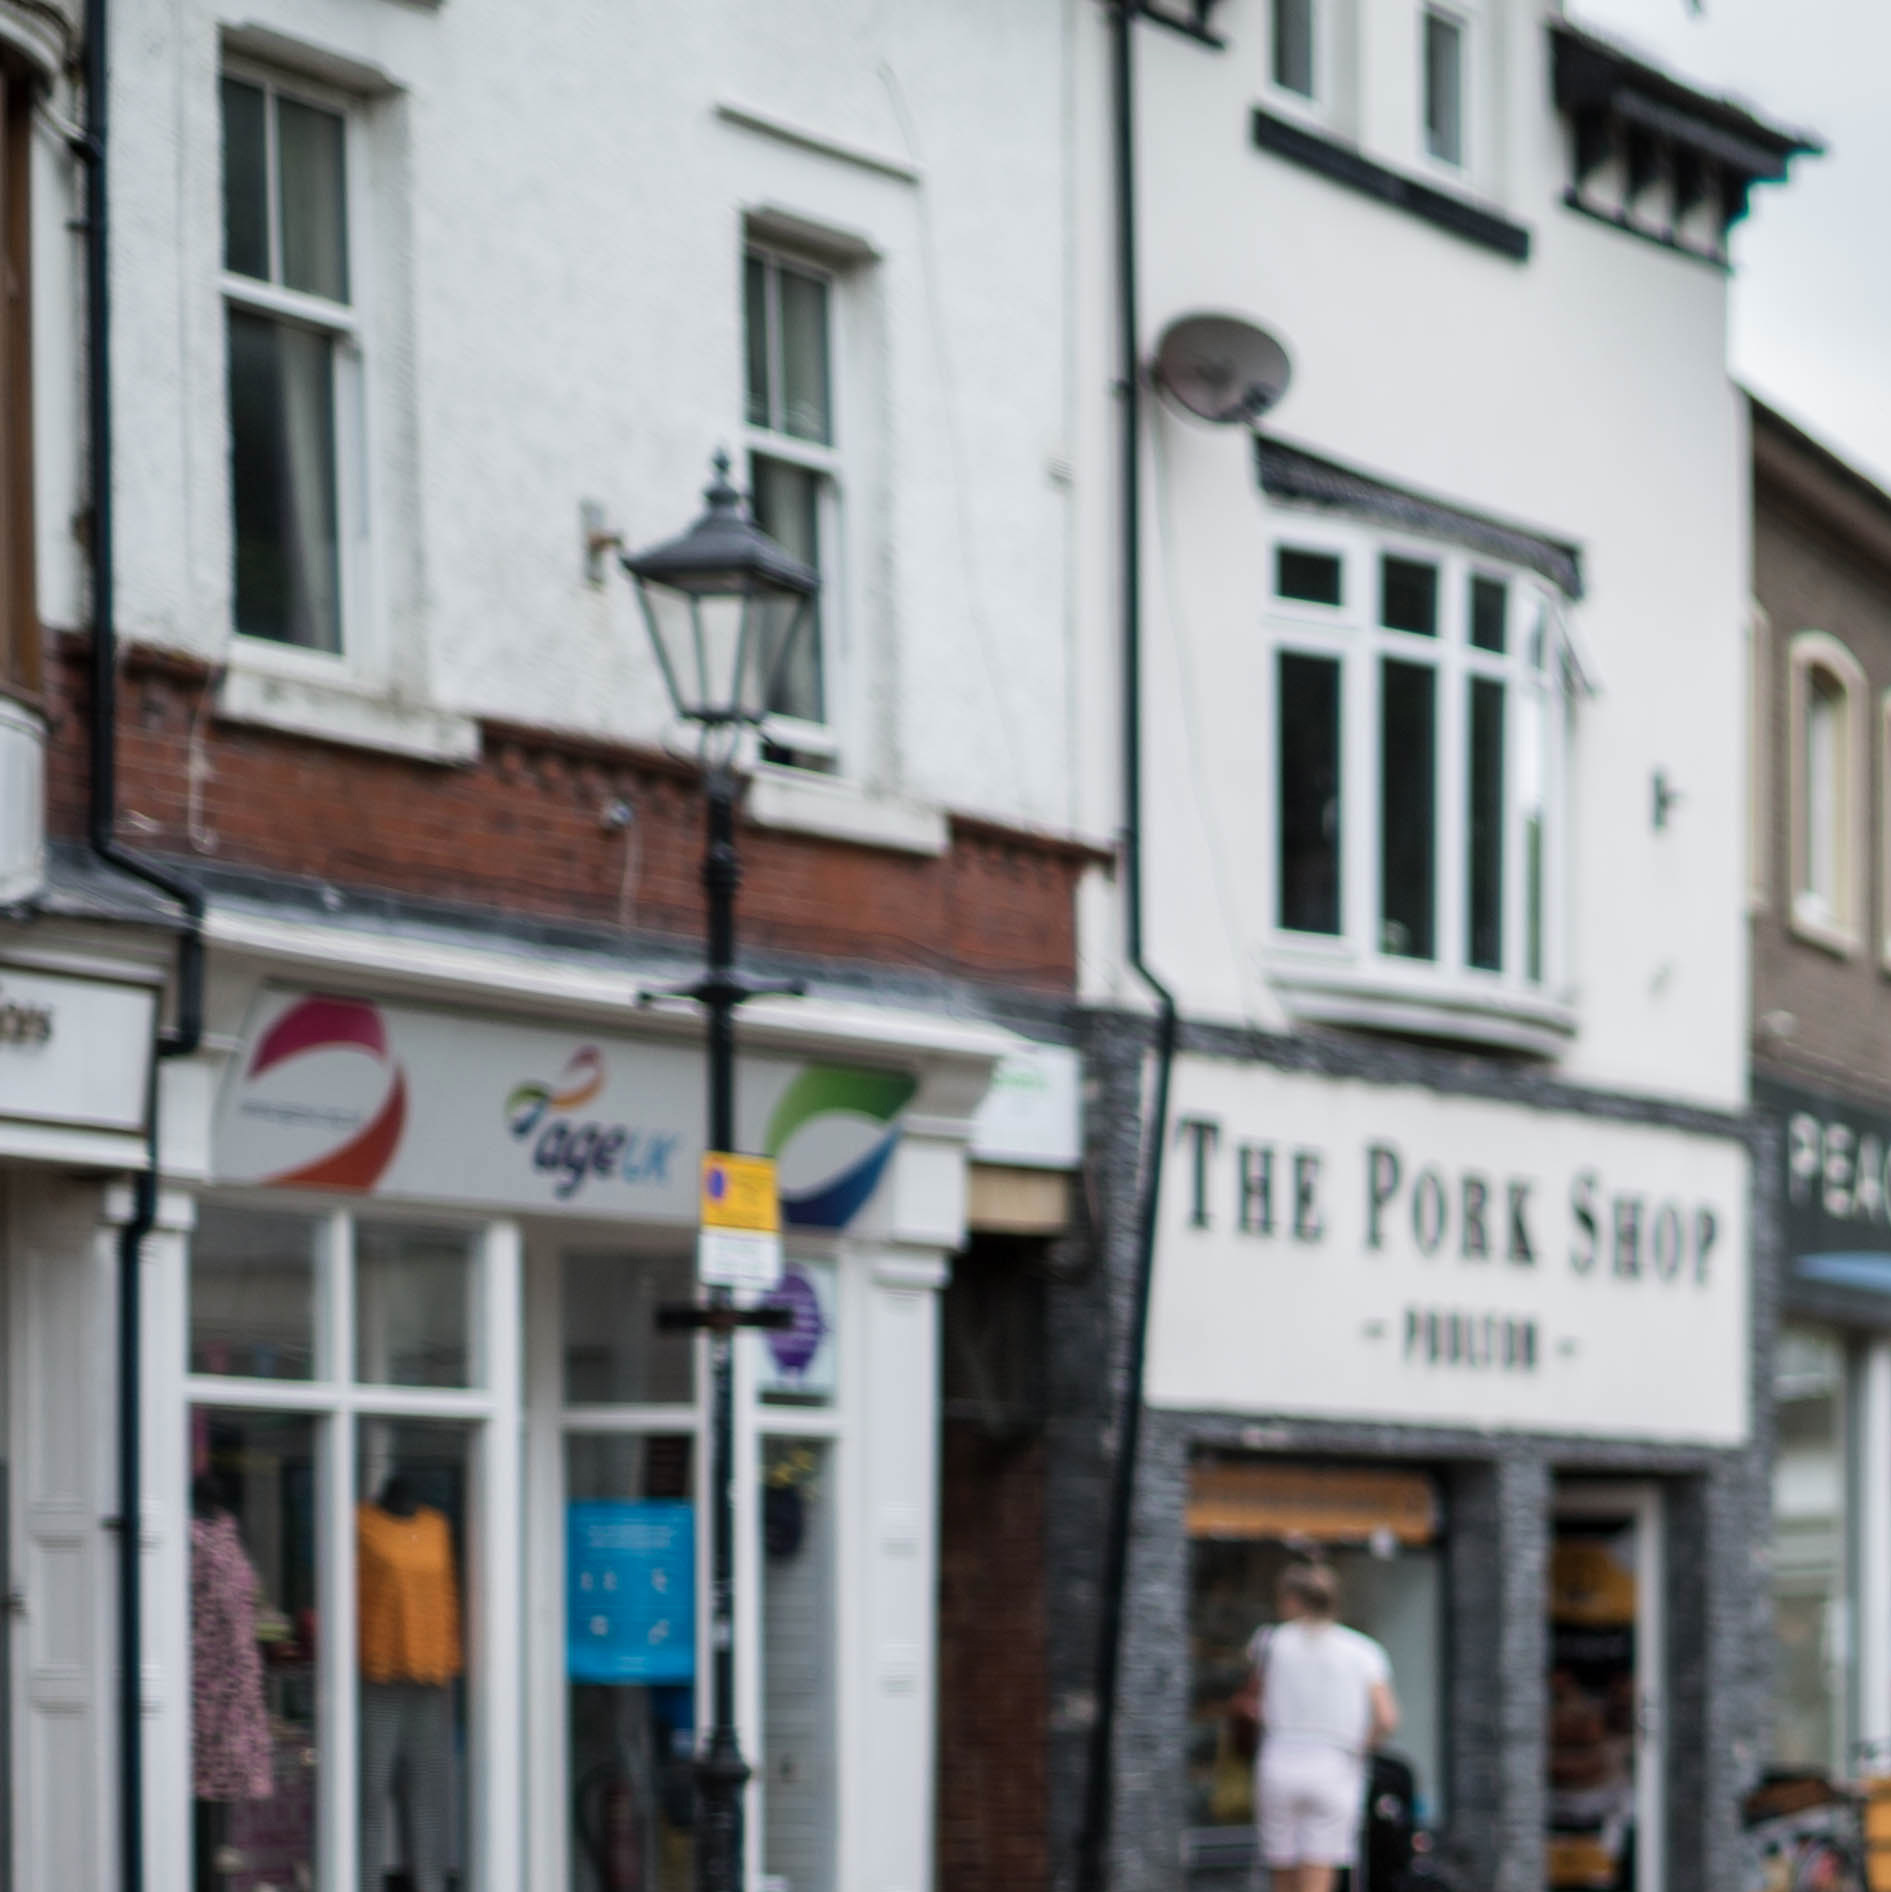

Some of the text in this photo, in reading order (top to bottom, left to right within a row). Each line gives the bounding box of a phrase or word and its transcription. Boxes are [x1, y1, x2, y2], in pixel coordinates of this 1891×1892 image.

[1177, 1114, 1718, 1285] THE PORK SHOP
